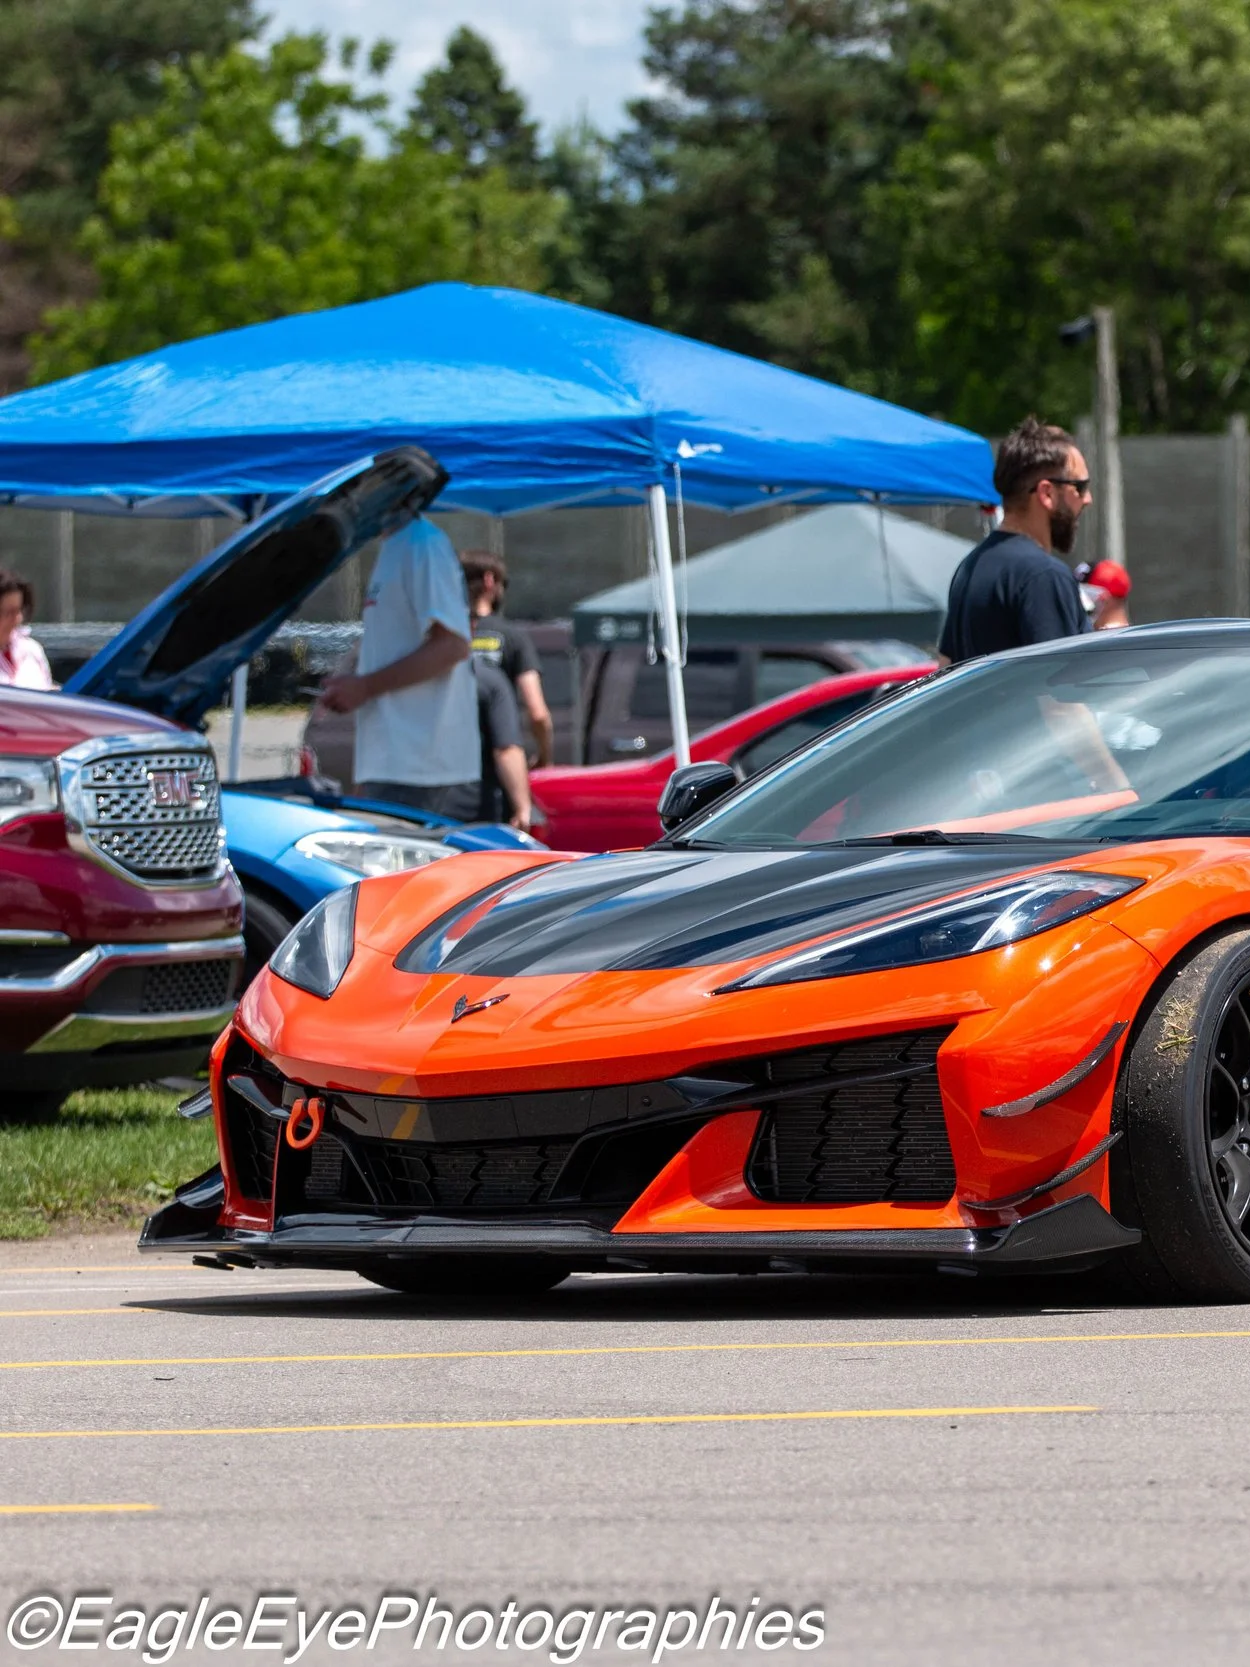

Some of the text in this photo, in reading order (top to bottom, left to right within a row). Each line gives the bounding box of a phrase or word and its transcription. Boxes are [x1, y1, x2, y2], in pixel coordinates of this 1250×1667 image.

[147, 770, 205, 808] GMC
[1202, 1183, 1249, 1274] TOYO TIRES
